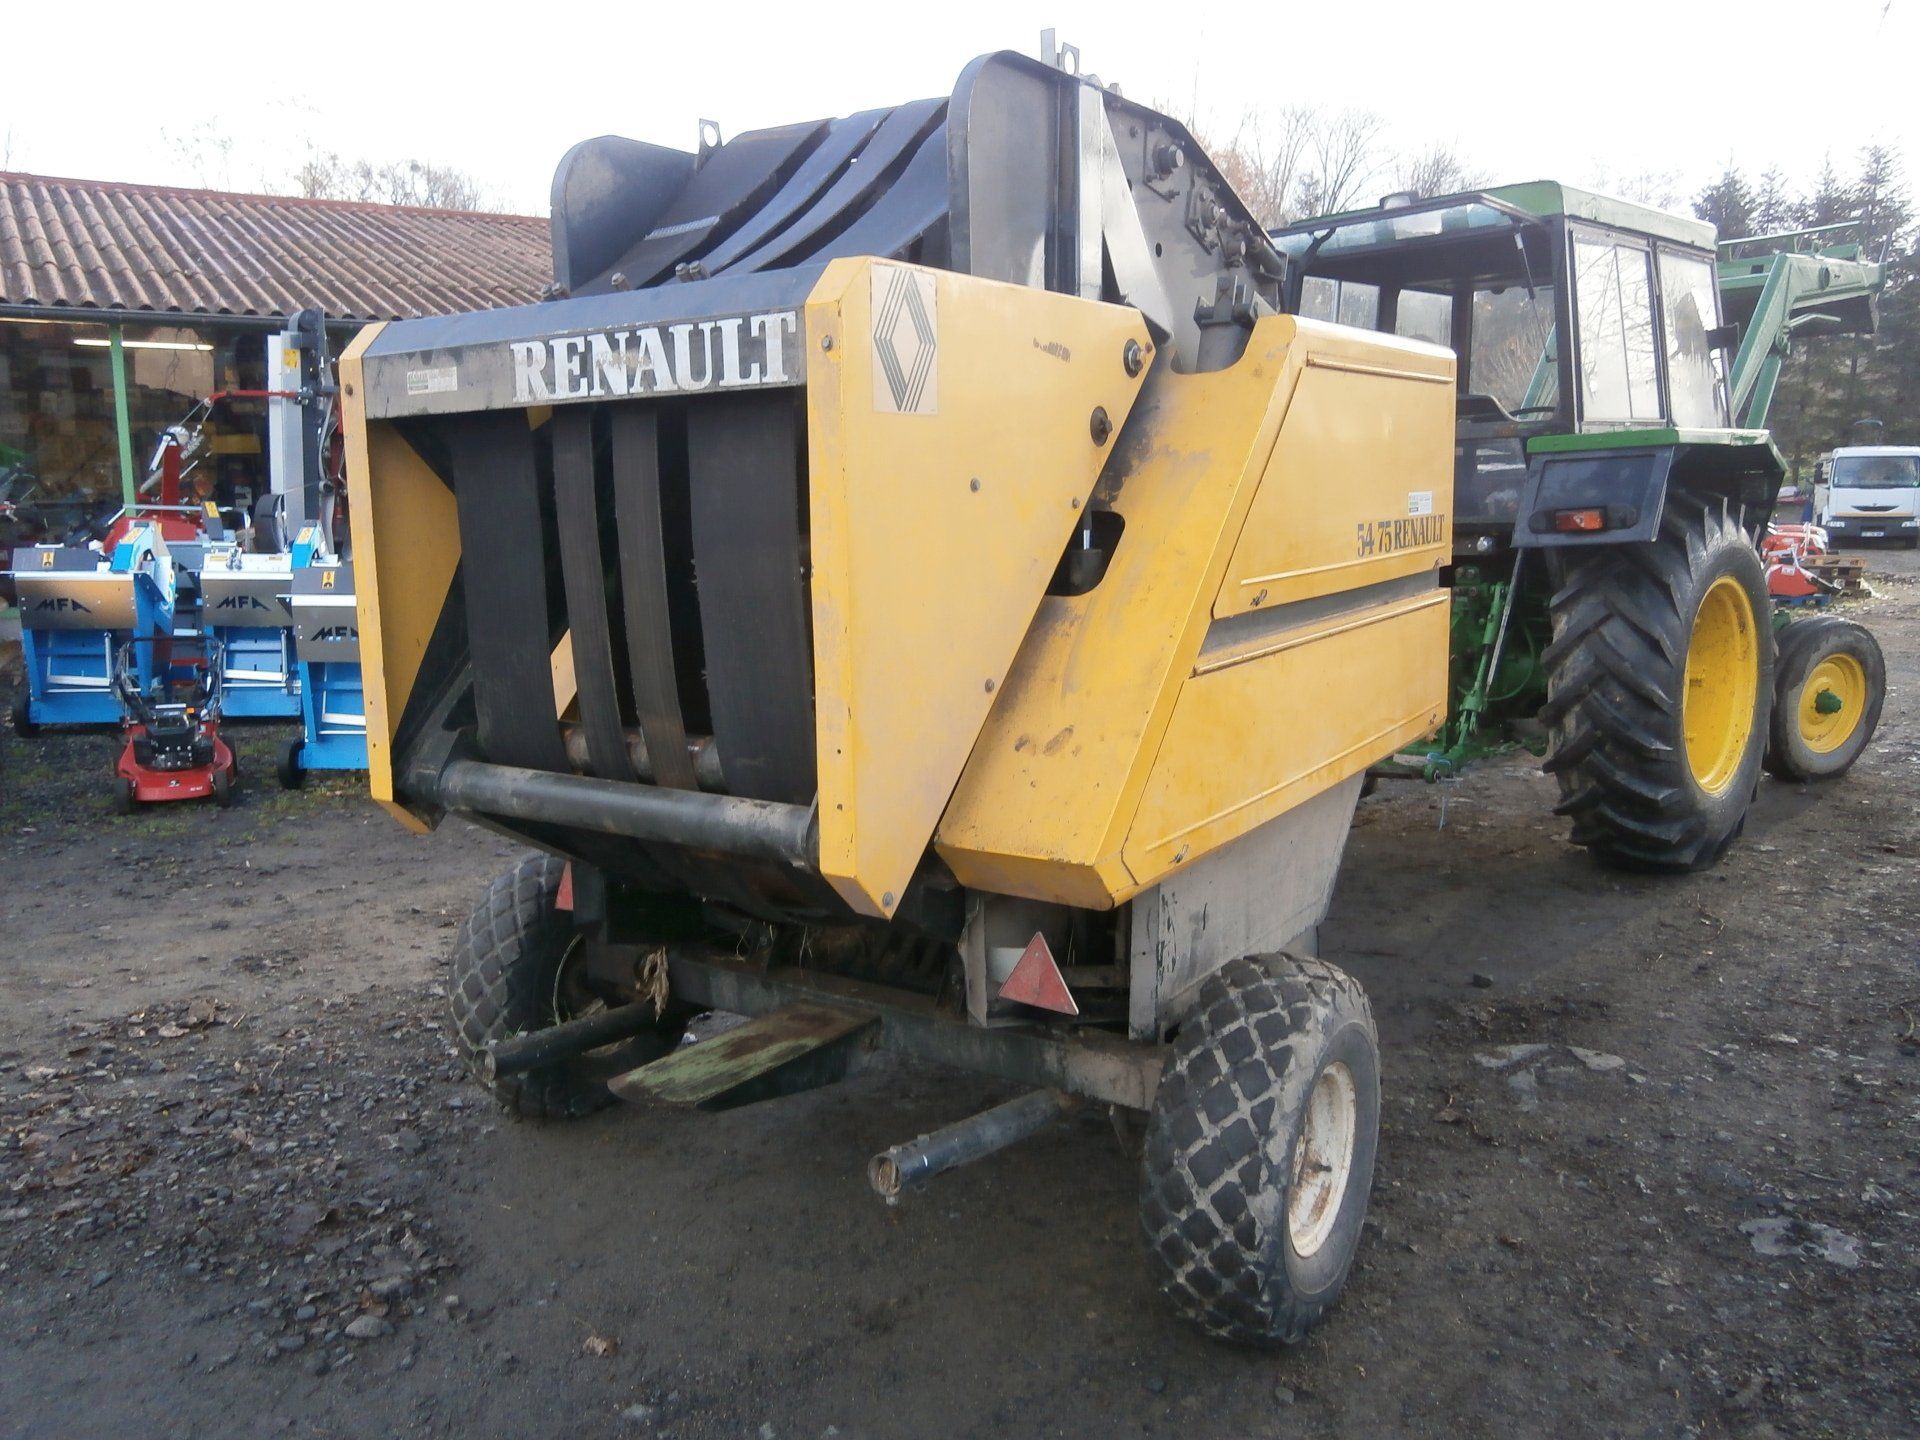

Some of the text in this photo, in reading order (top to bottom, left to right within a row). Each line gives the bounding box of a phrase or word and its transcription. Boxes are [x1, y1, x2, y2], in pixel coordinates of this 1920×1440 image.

[510, 310, 797, 403] RENAULT
[1357, 514, 1445, 557] 54 75 RENAULT
[33, 598, 92, 613] MFA
[216, 595, 271, 611] MFA
